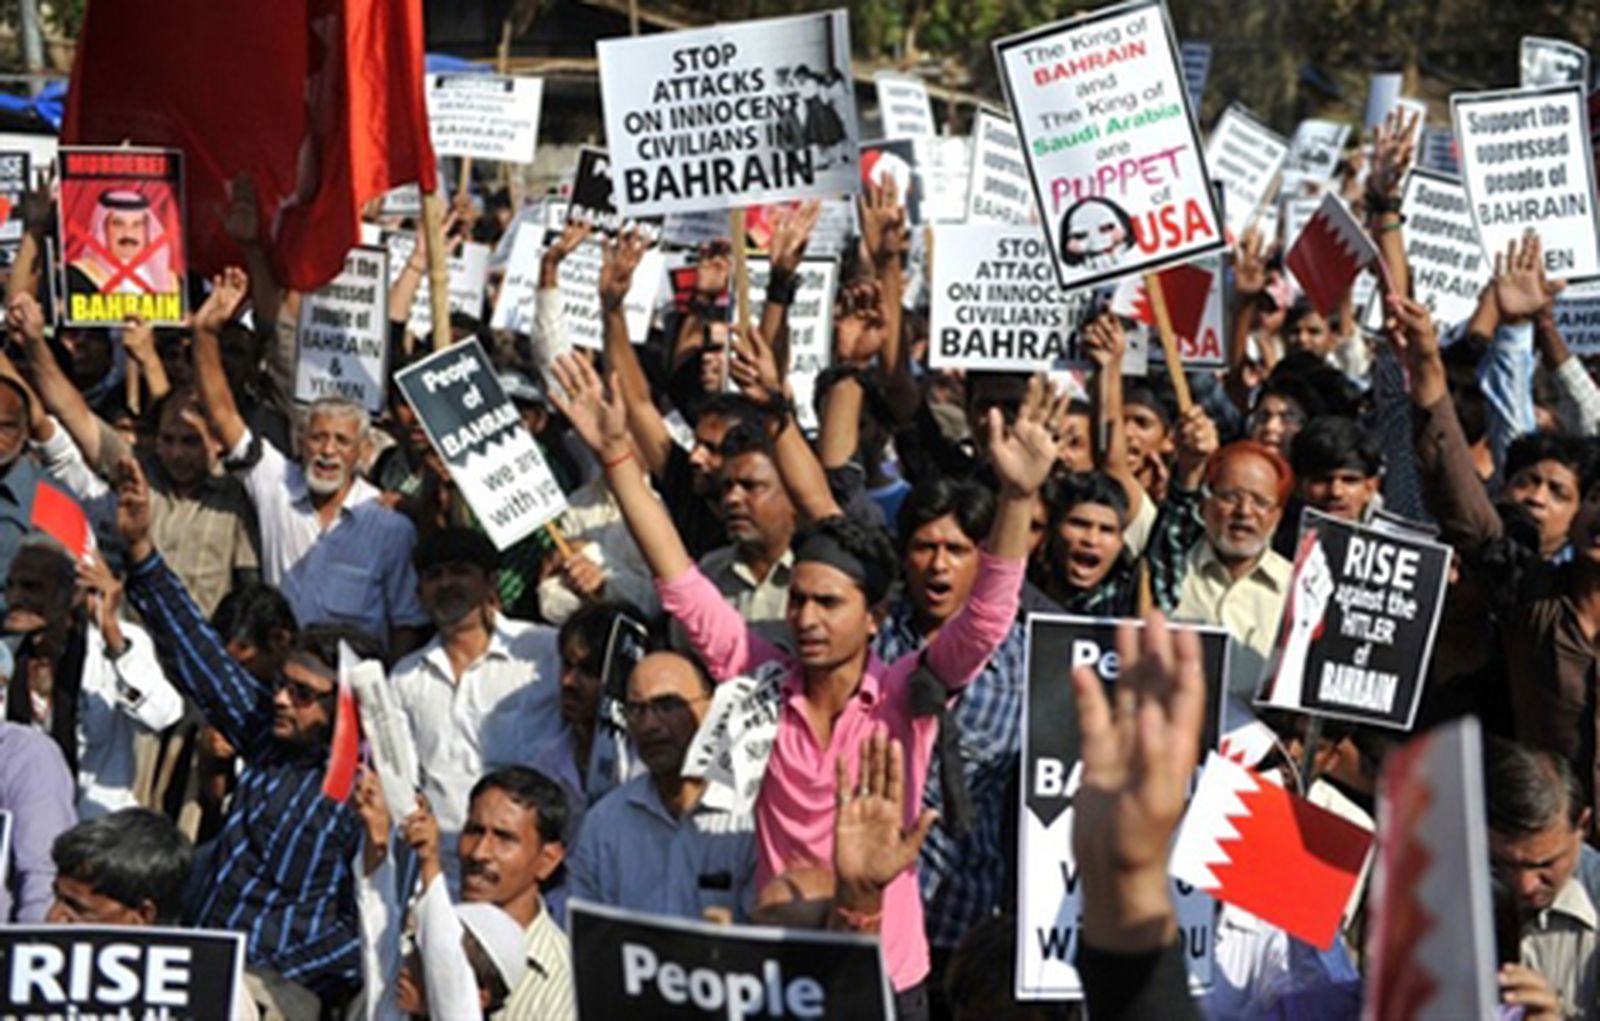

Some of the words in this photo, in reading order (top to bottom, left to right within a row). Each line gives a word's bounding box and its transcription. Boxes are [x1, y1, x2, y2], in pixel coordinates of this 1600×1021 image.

[1023, 43, 1066, 66] The
[1070, 27, 1121, 52] King
[1126, 17, 1148, 36] of
[673, 42, 737, 74] STOP
[1032, 40, 1148, 87] BAHRAIN
[653, 67, 766, 104] ATTACKS
[1076, 72, 1118, 99] and
[624, 108, 662, 135] ON
[670, 92, 800, 130] INNOCENT
[1039, 108, 1083, 130] The
[1087, 92, 1139, 118] King
[1142, 81, 1165, 100] of
[1468, 107, 1537, 134] Support
[1540, 104, 1570, 125] the
[637, 126, 759, 161] CIVILIANS
[766, 122, 797, 147] IN
[1033, 123, 1100, 157] Saudi
[1105, 103, 1182, 136] Arabia
[1096, 140, 1131, 161] are
[1476, 135, 1569, 163] oppressed
[624, 150, 815, 204] BAHRAIN
[1050, 144, 1189, 214] PUPPET
[1484, 169, 1544, 195] people
[1548, 164, 1568, 186] of
[1150, 186, 1173, 205] of
[1477, 194, 1587, 225] BAHRAIN
[1129, 197, 1214, 256] USA
[997, 238, 1047, 259] STO
[356, 257, 378, 279] the
[71, 293, 181, 321] BAHRAIN
[947, 282, 981, 301] ON
[955, 305, 1061, 327] CIVILIANS
[302, 329, 382, 358] BAHRAIN
[328, 357, 343, 378] &
[483, 463, 516, 492] we
[489, 488, 537, 528] with
[1343, 536, 1420, 590] RISE
[1334, 583, 1387, 613] against
[1386, 590, 1418, 620] the
[1353, 643, 1372, 667] of
[1318, 660, 1398, 714] BAHRAIN
[10, 942, 192, 1006] RISE
[622, 943, 825, 1021] People
